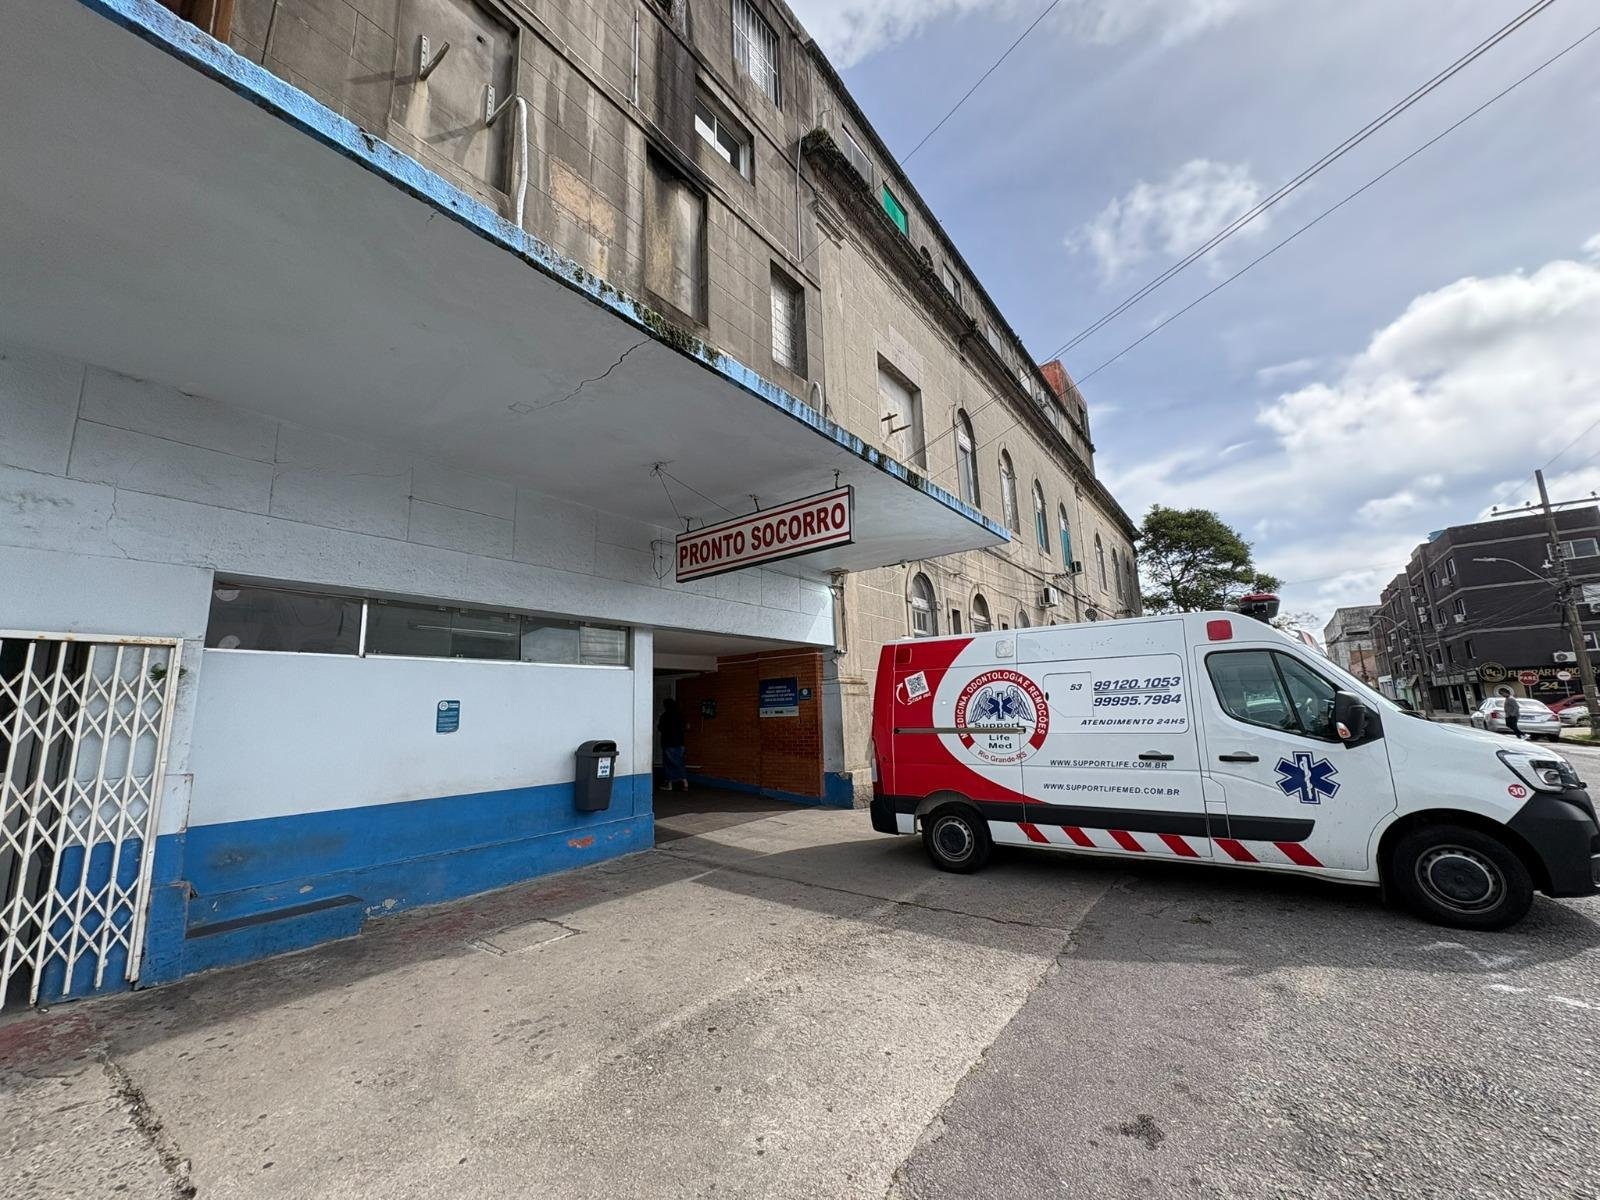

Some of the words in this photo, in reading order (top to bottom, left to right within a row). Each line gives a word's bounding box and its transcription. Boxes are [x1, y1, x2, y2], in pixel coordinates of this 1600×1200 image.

[679, 531, 745, 568] PRONTO
[751, 502, 846, 550] SOCORRO
[966, 671, 1023, 693] ODONTOLOGIA
[1022, 680, 1031, 688] E
[1069, 683, 1083, 691] 53
[1093, 676, 1181, 691] 99120.1053
[1539, 681, 1559, 690] 24
[1093, 693, 1182, 707] 99995.7984
[1080, 718, 1154, 726] ATENDIMENTO
[978, 750, 989, 760] Rio
[1049, 759, 1168, 769] WWW.SUPPORTLIFE.COM.BR
[1043, 783, 1180, 796] WWW.SUPPORTLIFEMED.COM.BR
[1510, 786, 1526, 796] 30
